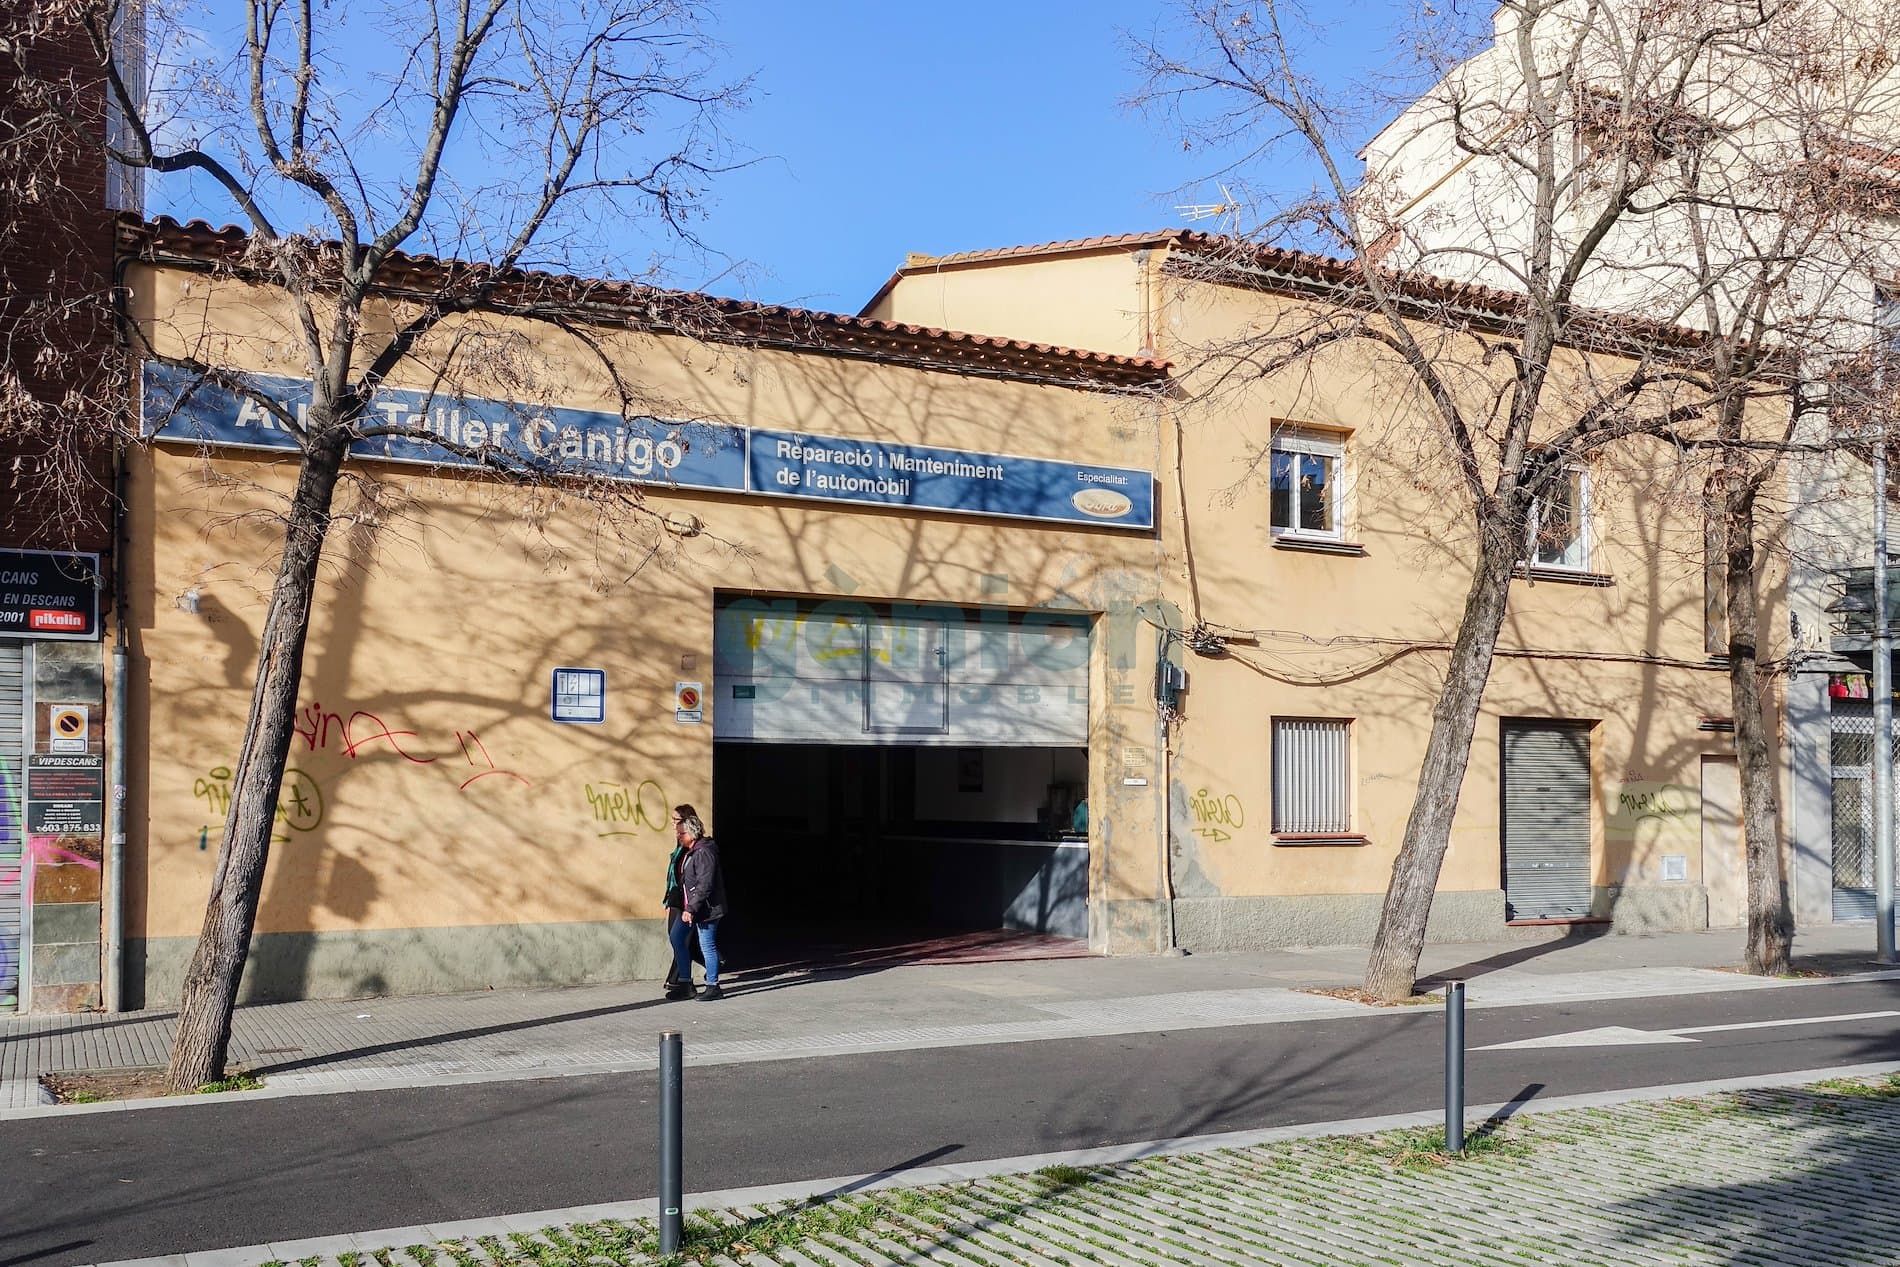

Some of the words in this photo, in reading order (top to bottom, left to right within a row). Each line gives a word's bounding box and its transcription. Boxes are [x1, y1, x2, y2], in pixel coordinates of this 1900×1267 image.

[235, 397, 359, 437] Au
[376, 402, 510, 448] Taller
[524, 418, 682, 475] Canigó
[776, 440, 873, 467] Reparació
[878, 451, 884, 468] i
[889, 453, 1004, 480] Manteniment
[776, 468, 800, 486] de
[806, 470, 910, 496] l'automòbil
[1077, 471, 1129, 485] Especialitat:
[0, 570, 39, 585] CANS
[4, 593, 19, 605] EN
[22, 594, 76, 607] DESCANS
[35, 612, 81, 627] pikolin
[39, 757, 98, 766] VIPDESCANS
[63, 823, 81, 832] 875
[83, 823, 101, 832] 833
